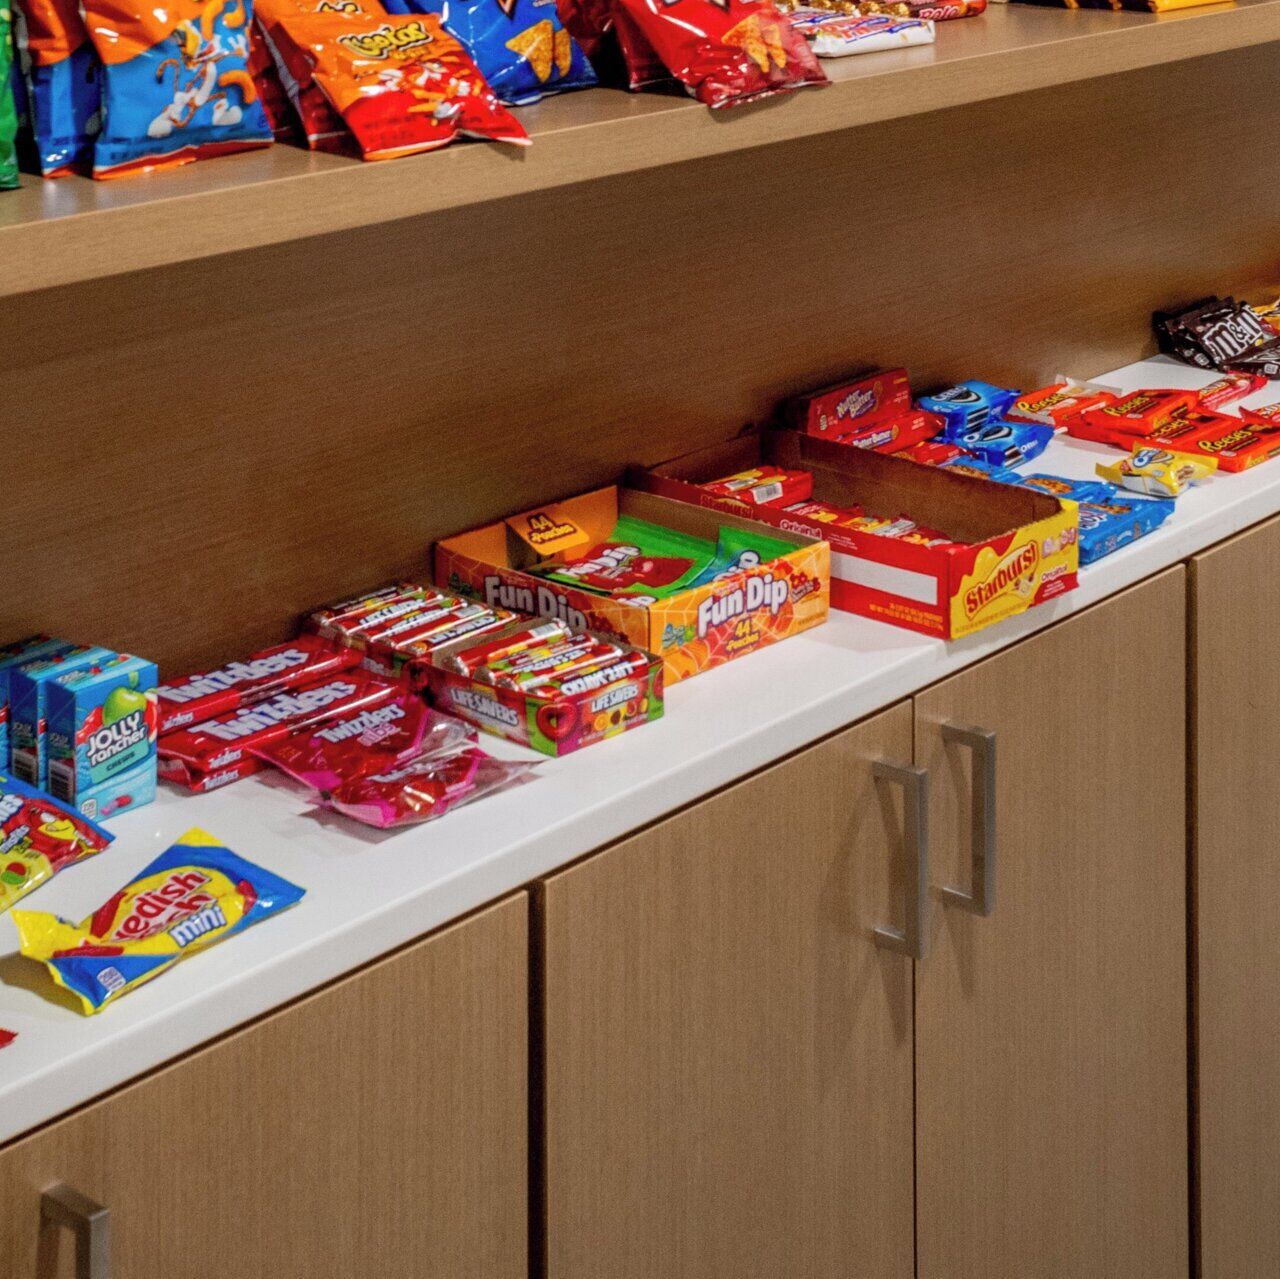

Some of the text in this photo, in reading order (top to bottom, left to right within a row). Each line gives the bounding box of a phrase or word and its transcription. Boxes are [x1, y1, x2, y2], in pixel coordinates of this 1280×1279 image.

[837, 390, 860, 418] Nutter
[850, 390, 874, 418] Butter
[1199, 430, 1252, 453] Reese's
[530, 515, 549, 530] 44
[780, 520, 822, 539] Original
[966, 543, 1036, 614] Starburst
[1041, 565, 1068, 582] Original
[485, 578, 533, 611] Fun
[699, 573, 789, 637] Fun Dip
[736, 620, 752, 636] 44
[158, 650, 310, 703] Twizzlers
[188, 681, 356, 740] Twizzlers
[314, 704, 405, 743] Twizzlers
[87, 710, 142, 758] JOLLY
[89, 728, 146, 767] rancher
[169, 905, 227, 947] mini
